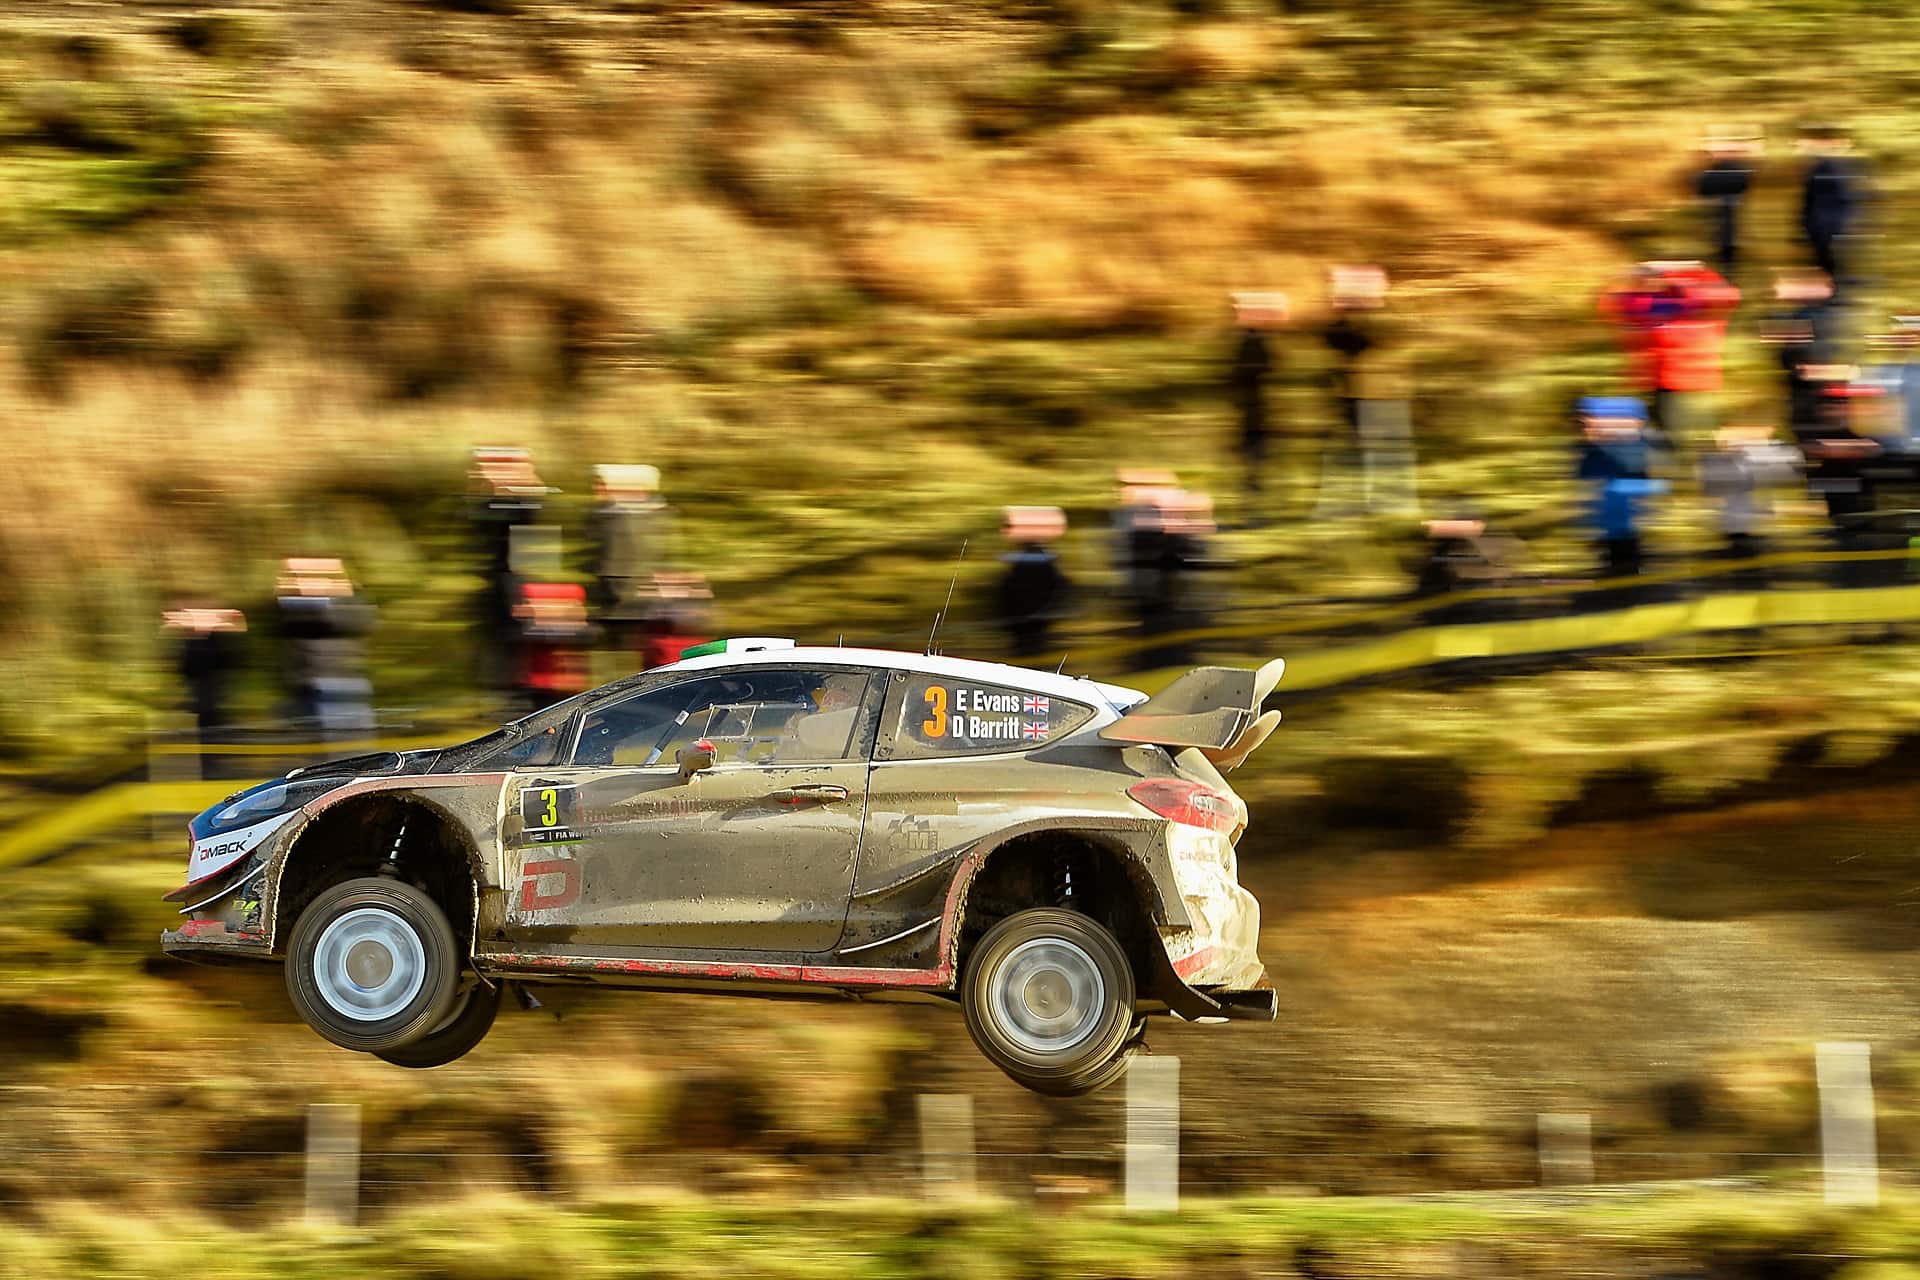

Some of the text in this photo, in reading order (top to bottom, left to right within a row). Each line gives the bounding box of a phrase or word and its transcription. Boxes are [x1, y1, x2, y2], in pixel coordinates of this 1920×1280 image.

[923, 685, 948, 738] 3
[956, 689, 1020, 713] E Evans
[952, 716, 1020, 739] D Barritt
[540, 789, 557, 826] 3
[555, 831, 569, 839] FIA
[200, 839, 248, 861] DMACK
